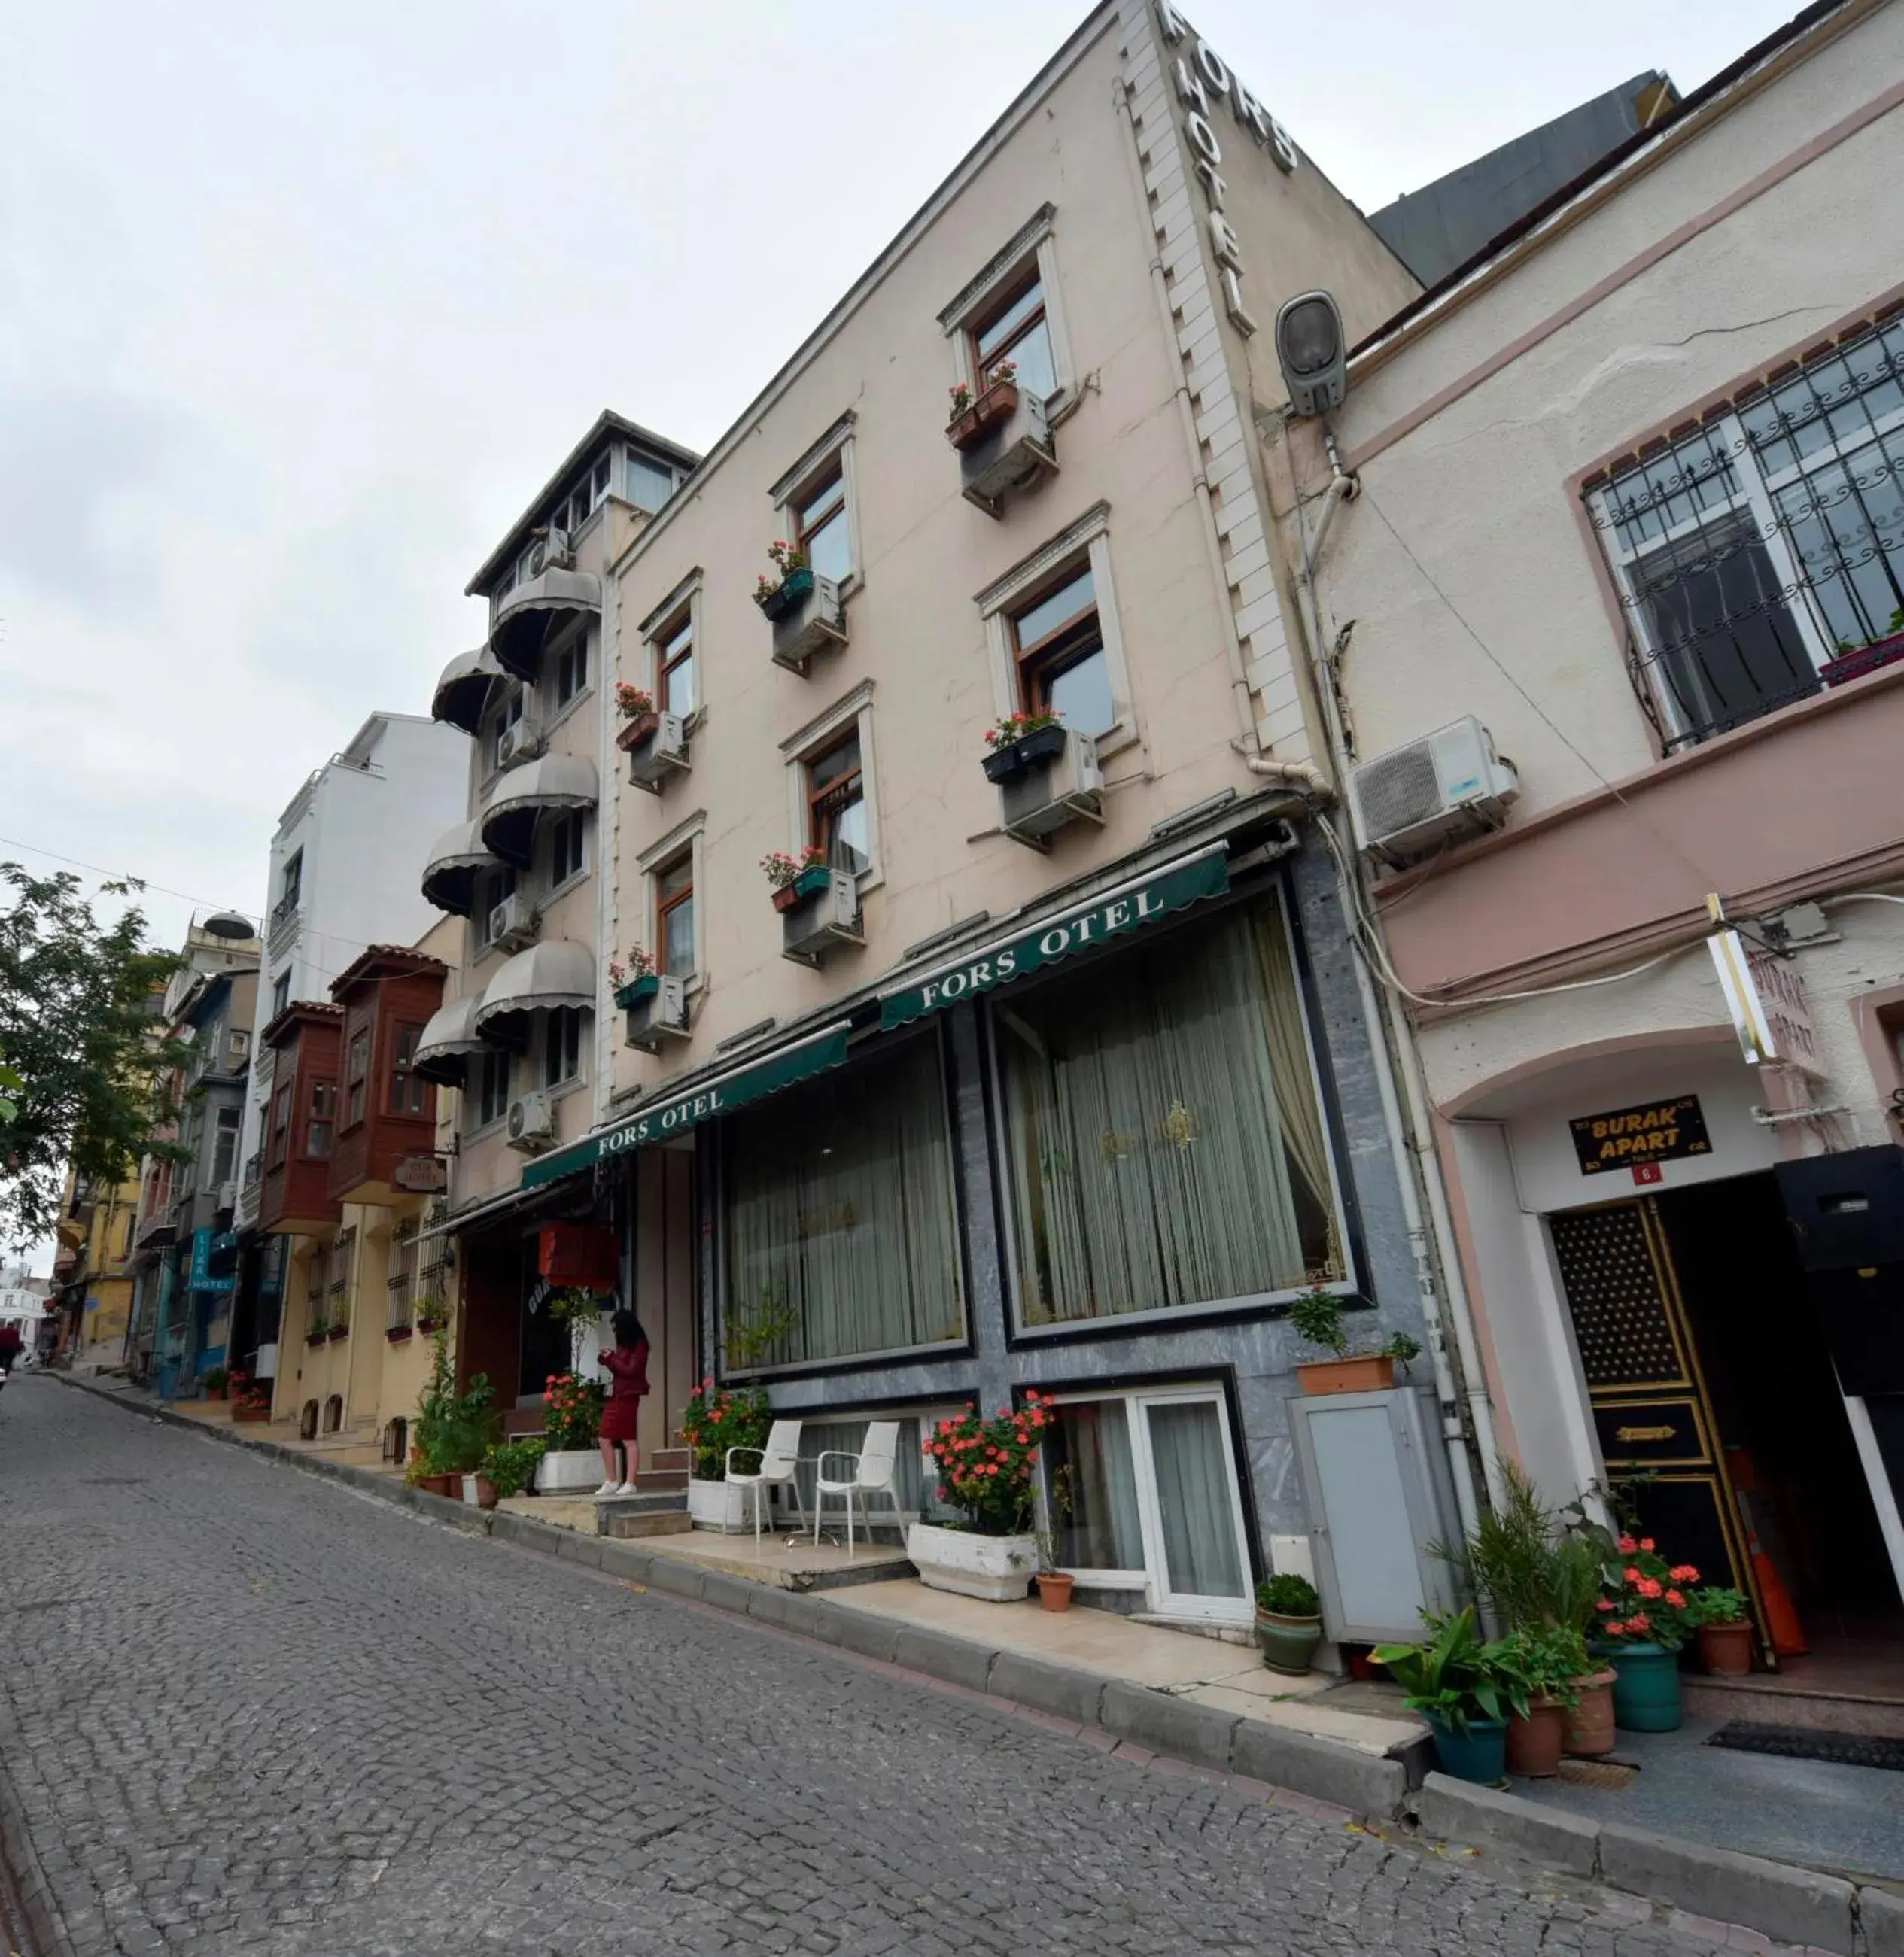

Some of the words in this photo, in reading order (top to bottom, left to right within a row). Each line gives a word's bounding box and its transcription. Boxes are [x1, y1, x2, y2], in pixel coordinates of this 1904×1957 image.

[1153, 0, 1297, 175] FORS
[1170, 57, 1258, 339] HOTEL
[922, 950, 1016, 1009] FORS
[1040, 889, 1165, 956] OTEL
[598, 1120, 649, 1156] FORS
[662, 1090, 724, 1129] OTEL
[1592, 1105, 1677, 1138] BURAK
[1600, 1128, 1680, 1159] APART
[192, 1280, 232, 1289] HOTEL
